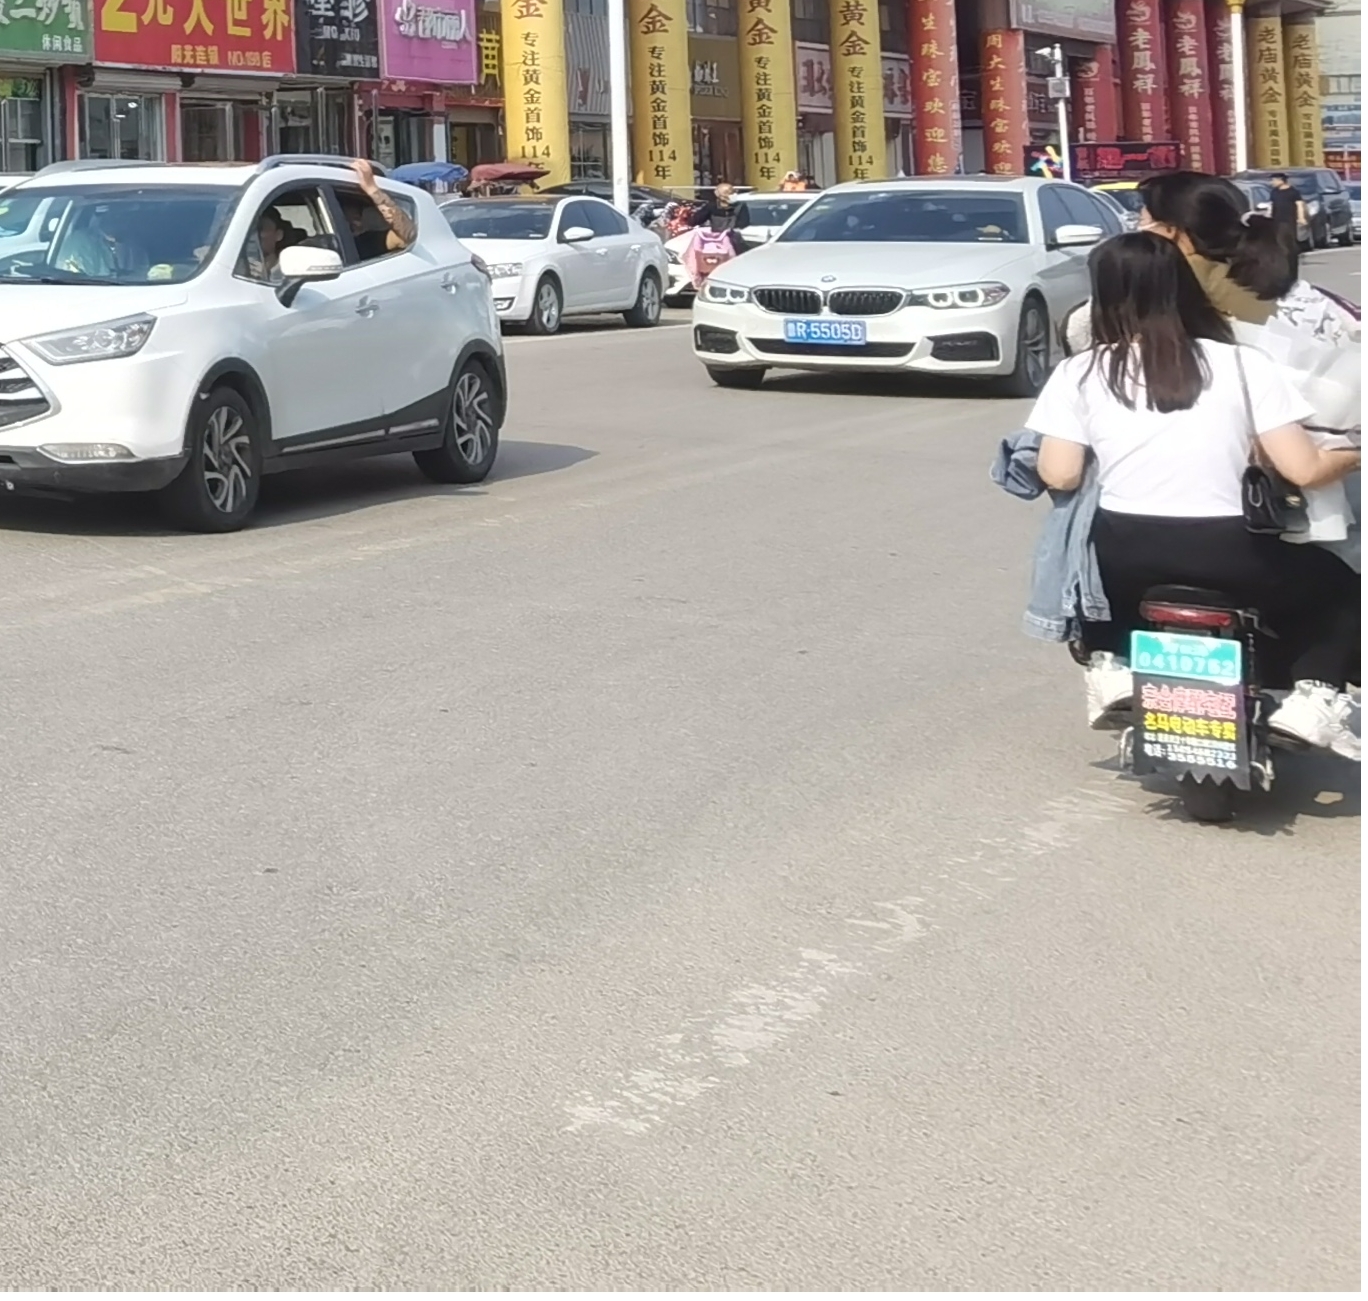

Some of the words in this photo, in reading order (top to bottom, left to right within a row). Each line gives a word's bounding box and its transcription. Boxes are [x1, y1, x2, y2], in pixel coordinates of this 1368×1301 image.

[1257, 26, 1282, 105] 老庙黄金
[1292, 34, 1317, 107] 老庙黄金
